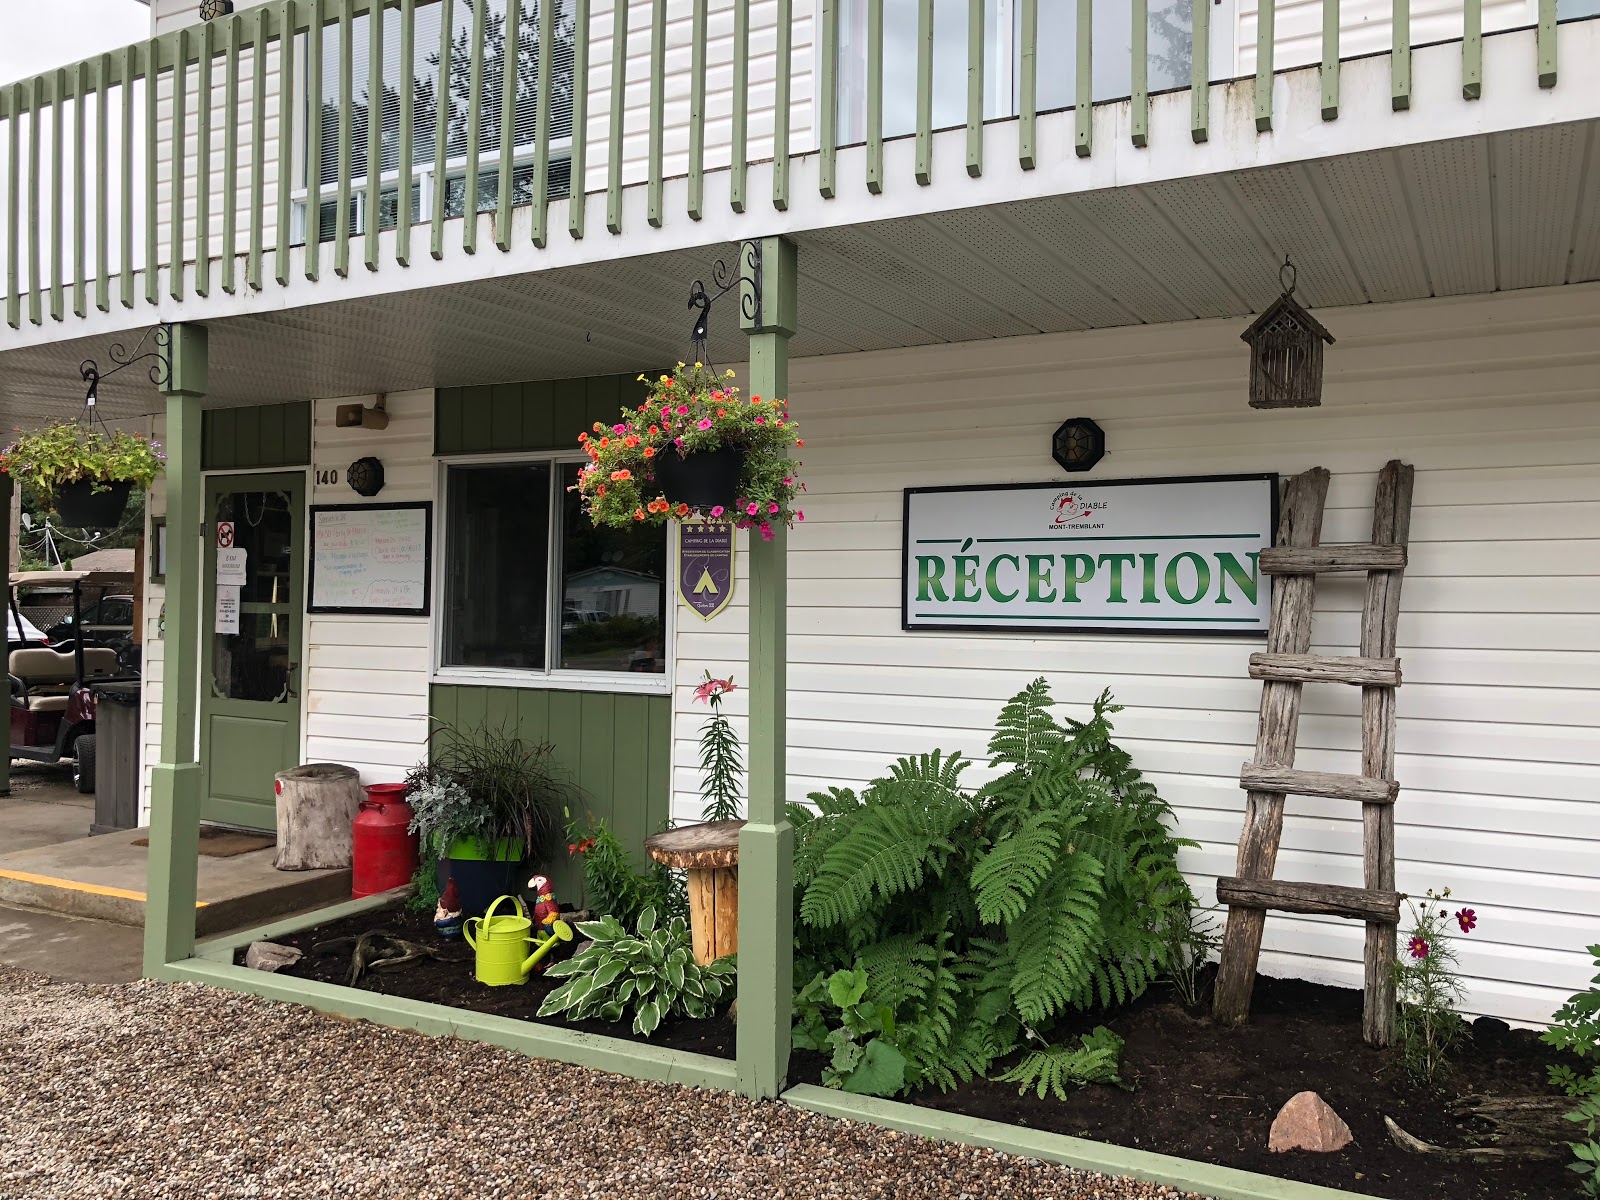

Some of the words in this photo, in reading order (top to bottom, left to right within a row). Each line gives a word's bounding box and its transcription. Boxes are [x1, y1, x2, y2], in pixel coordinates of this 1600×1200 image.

[316, 469, 338, 485] 140
[1050, 491, 1069, 510] Camping
[1080, 502, 1108, 510] DIABLE
[915, 537, 1261, 606] RÉCEPTION
